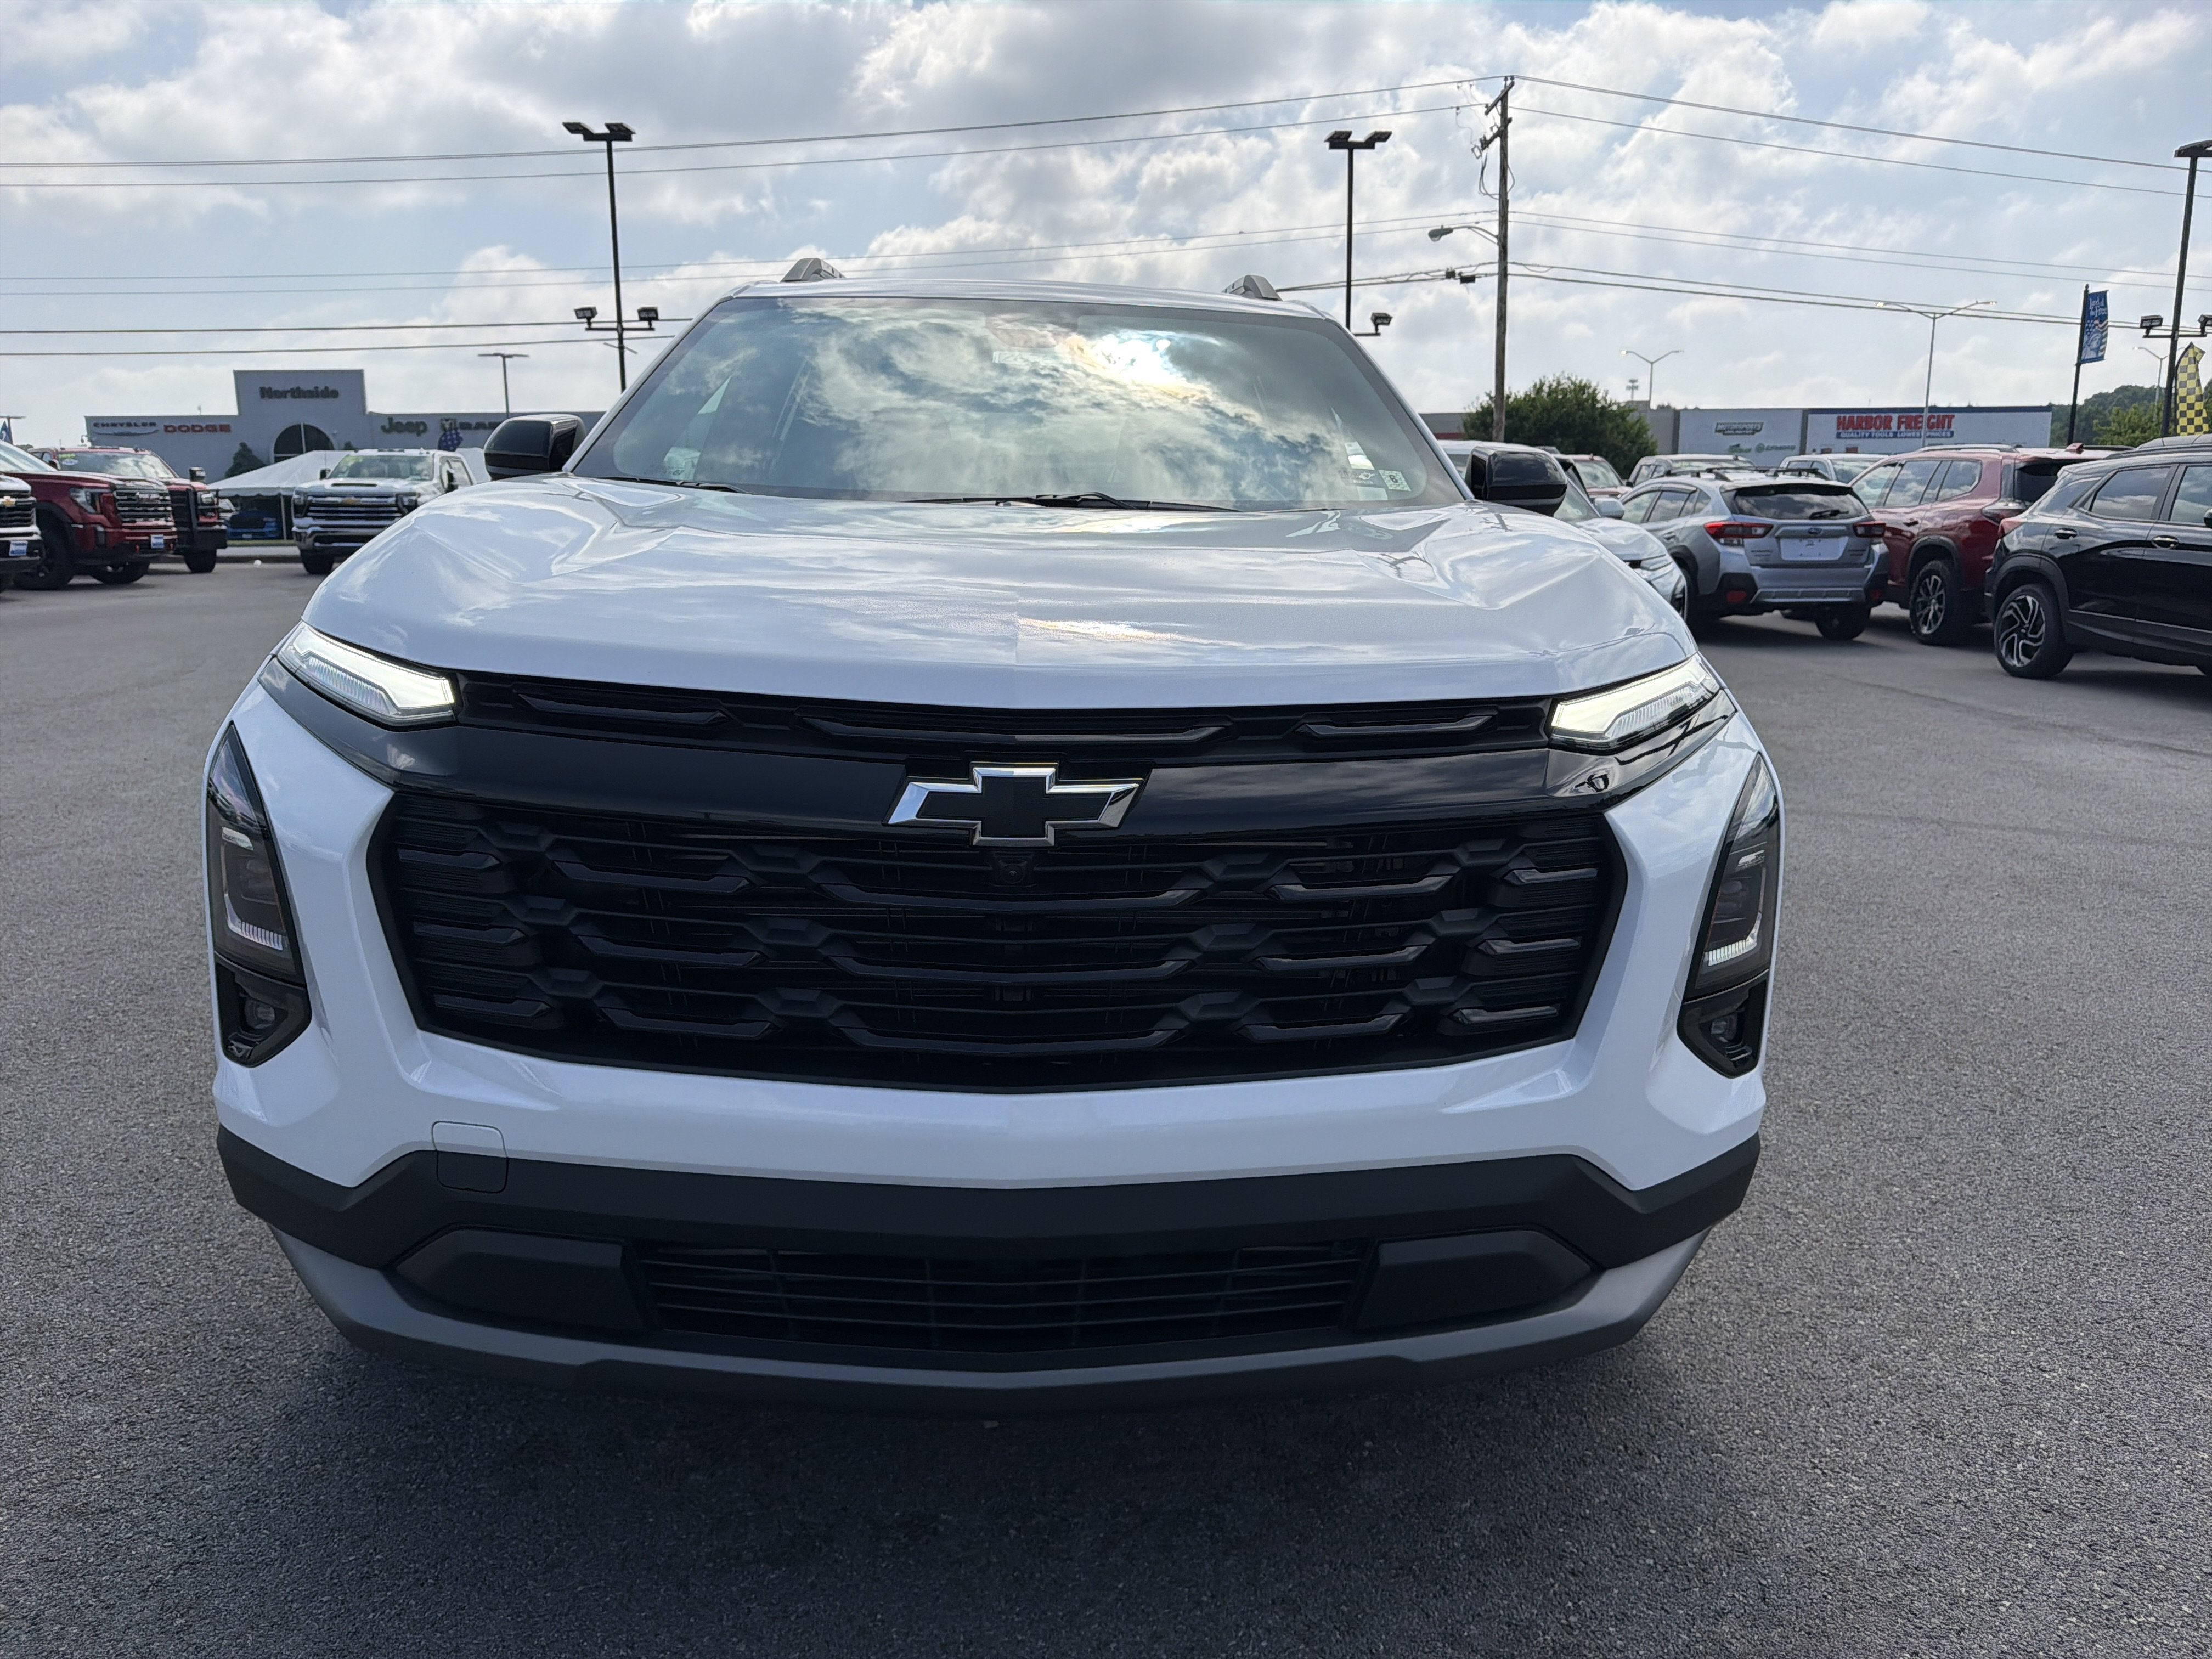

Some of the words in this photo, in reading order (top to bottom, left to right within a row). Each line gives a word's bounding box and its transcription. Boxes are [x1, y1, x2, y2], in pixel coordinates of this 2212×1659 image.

[2095, 306, 2107, 318] Free
[259, 386, 339, 399] Northside
[163, 424, 231, 433] DODGE
[381, 417, 428, 437] Jeep
[1837, 415, 1893, 431] HARBOR
[1897, 414, 1955, 430] FREGHT
[1389, 475, 1398, 483] 6
